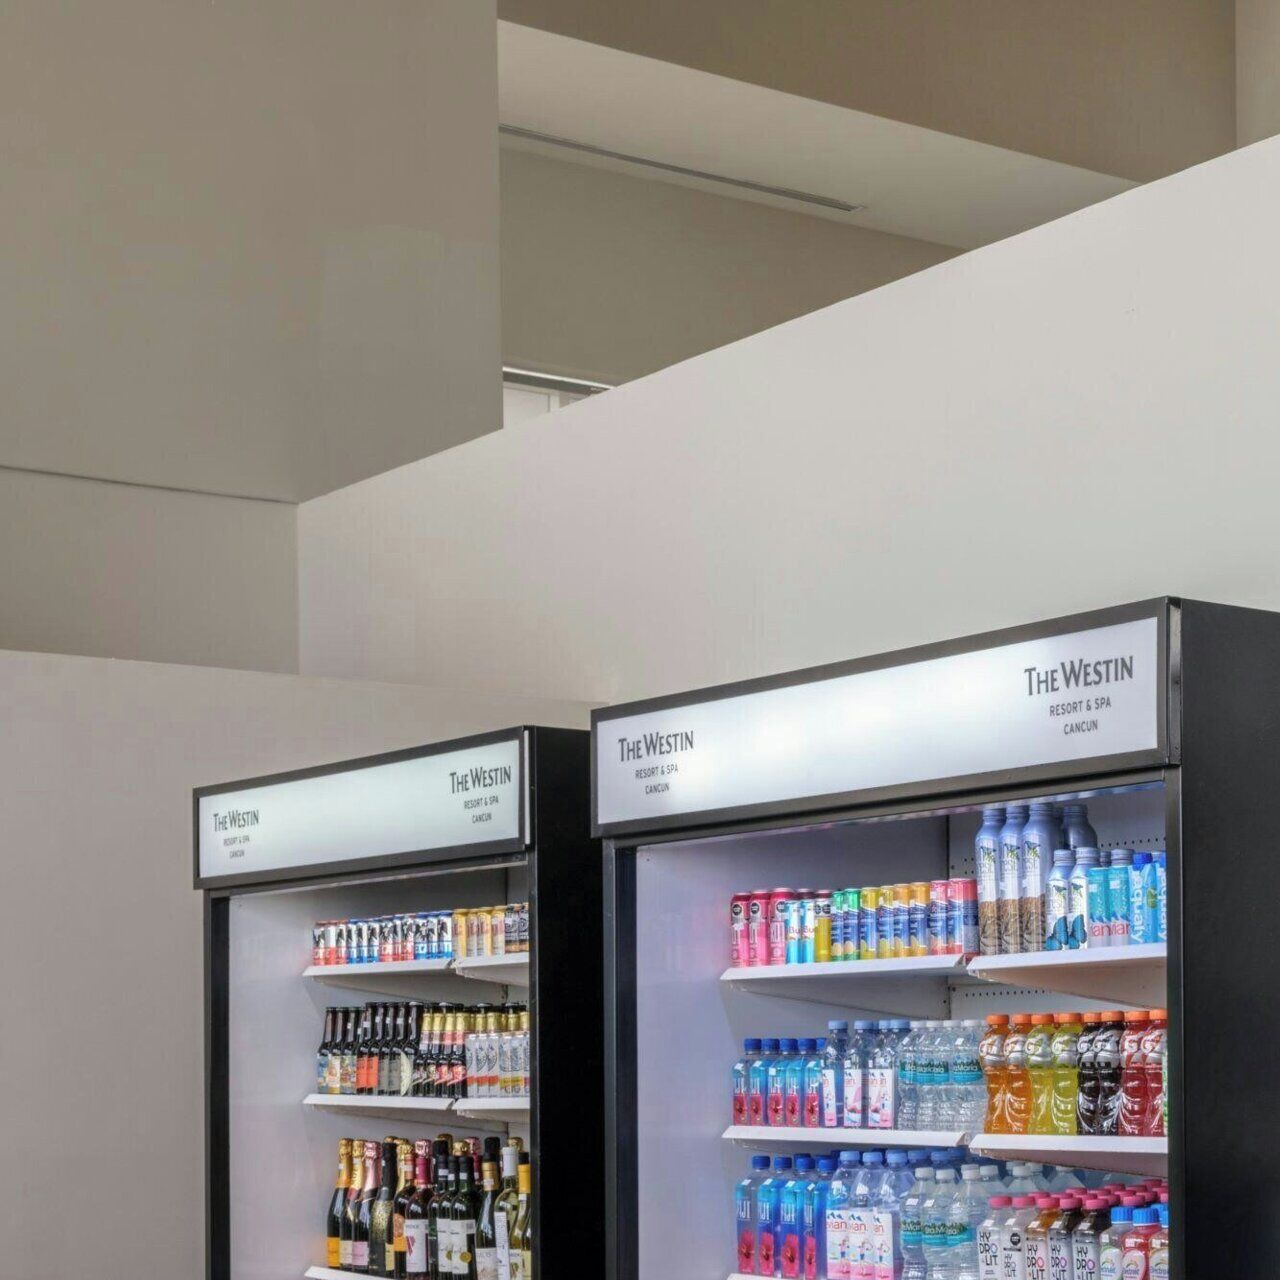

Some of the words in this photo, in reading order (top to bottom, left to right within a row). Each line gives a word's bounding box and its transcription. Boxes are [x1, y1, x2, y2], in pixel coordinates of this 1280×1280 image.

[1024, 666, 1059, 697] THE
[1061, 655, 1134, 690] WESTIN
[1049, 699, 1082, 718] RESORT
[1086, 698, 1093, 711] &
[1095, 695, 1112, 710] SPA
[1063, 719, 1098, 735] CANCUN
[618, 737, 642, 762] THE
[643, 730, 694, 755] WESTIN
[449, 771, 469, 794] THE
[470, 765, 512, 788] WESTIN
[635, 765, 659, 780] RESORT
[660, 764, 666, 776] &
[666, 763, 679, 775] SPA
[645, 781, 670, 795] CANCUN
[464, 798, 483, 810] RESORT
[485, 797, 489, 807] &
[489, 795, 499, 806] SPA
[472, 813, 492, 824] CANCUN
